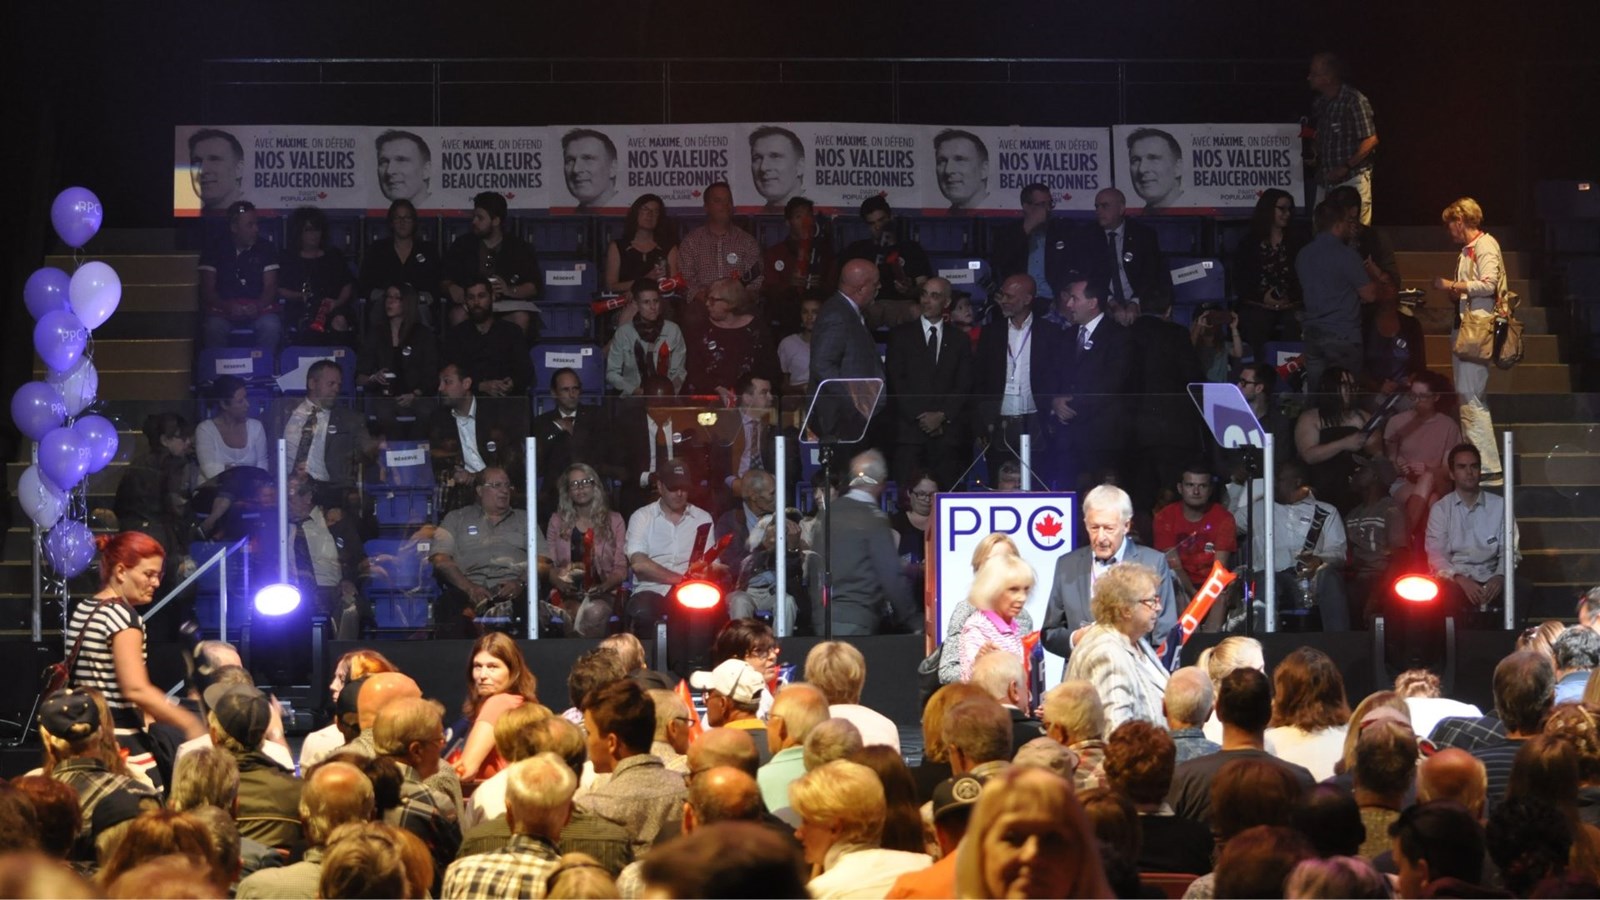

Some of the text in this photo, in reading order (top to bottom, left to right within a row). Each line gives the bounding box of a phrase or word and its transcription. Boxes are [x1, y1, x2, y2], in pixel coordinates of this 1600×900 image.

[255, 136, 355, 149] AVEC MAXIME, ON DÉFEND
[442, 138, 542, 150] AVEC MAXIME, ON DÉFEND
[628, 135, 728, 148] AVEC MAXIME, ON DÉFEND
[815, 135, 914, 147] AVEC MAXIME, ON DÉFEND
[999, 138, 1098, 151] AVEC MAXIME, ON DÉFEND
[1192, 134, 1290, 147] AVEC MAXIME, ON DÉFEND
[255, 151, 355, 169] NOS VALEURS
[442, 152, 542, 170] NOS VALEURS
[628, 149, 728, 168] NOS VALEURS
[815, 149, 914, 168] NOS VALEURS
[1000, 153, 1098, 171] NOS VALEURS
[1193, 149, 1290, 168] NOS VALEURS
[255, 172, 355, 188] BEAUCERONNES
[442, 173, 542, 188] BEAUCERONNES
[815, 170, 914, 187] BEAUCERONNES
[1193, 170, 1291, 186] BEAUCERONNES
[61, 329, 84, 343] PPC
[950, 506, 1065, 551] PPC
